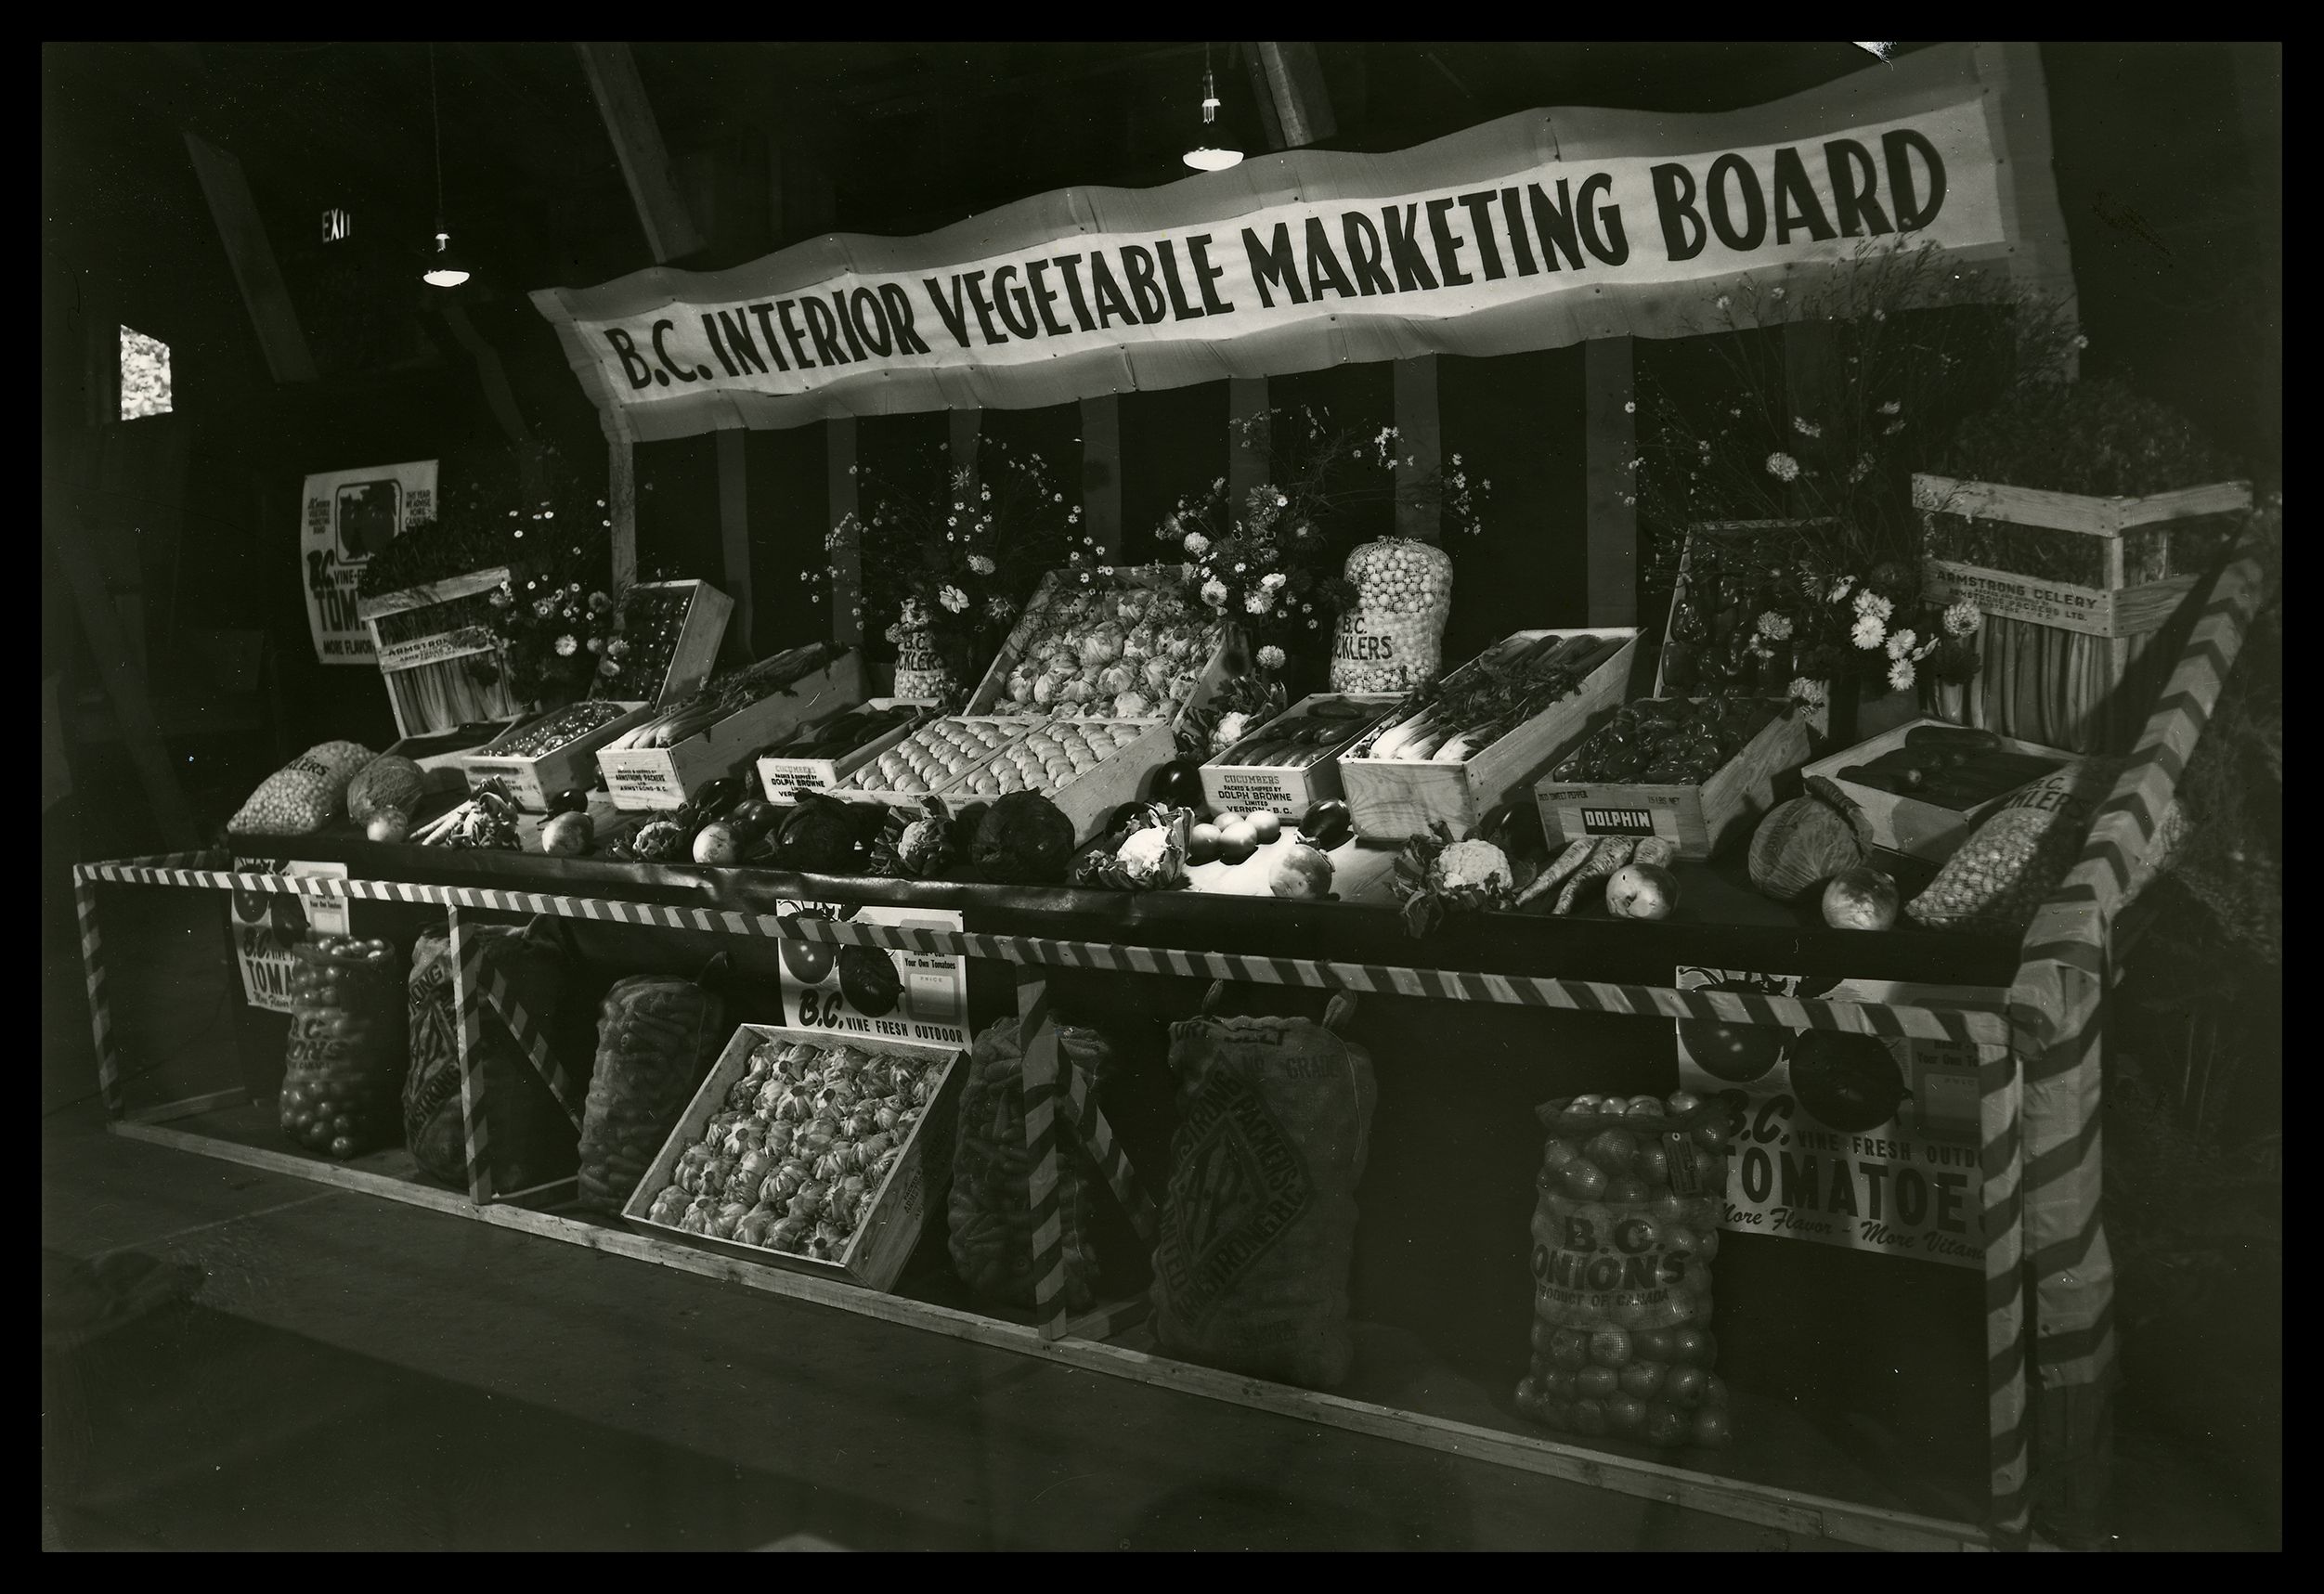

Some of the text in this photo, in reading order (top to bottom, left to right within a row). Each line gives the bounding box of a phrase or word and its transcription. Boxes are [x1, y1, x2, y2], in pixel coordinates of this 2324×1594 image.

[604, 128, 1946, 390] B.C. INTERIOR VEGETABLE MARKETING BOARD
[1937, 570, 2097, 609] ARMSTRONG CELERY
[314, 588, 368, 631] TOM
[1344, 616, 1368, 634] B.C.
[1335, 635, 1393, 660] CKLERS
[772, 778, 825, 787] DOLPH BROWNE
[1224, 774, 1279, 784] CUCUMBERS
[1218, 790, 1292, 801] DOLPH BROWNE
[1584, 810, 1652, 827] DOLPHIN
[904, 957, 956, 970] Your Own Tomatoes
[798, 988, 845, 1030] B.C.
[846, 1017, 964, 1044] VINE FRESH OUTDOOR
[1965, 1054, 1980, 1068] To
[1798, 1129, 1839, 1152] VINE
[1853, 1136, 1911, 1161] FRESH
[1724, 1145, 1983, 1236] OMATOE
[1564, 1215, 1666, 1254] B.C.
[1770, 1207, 1835, 1235] Flavor
[1861, 1220, 1915, 1250] More
[1533, 1244, 1694, 1291] ONIONS
[1591, 1293, 1609, 1307] OF
[1616, 1288, 1669, 1307] CANADA
